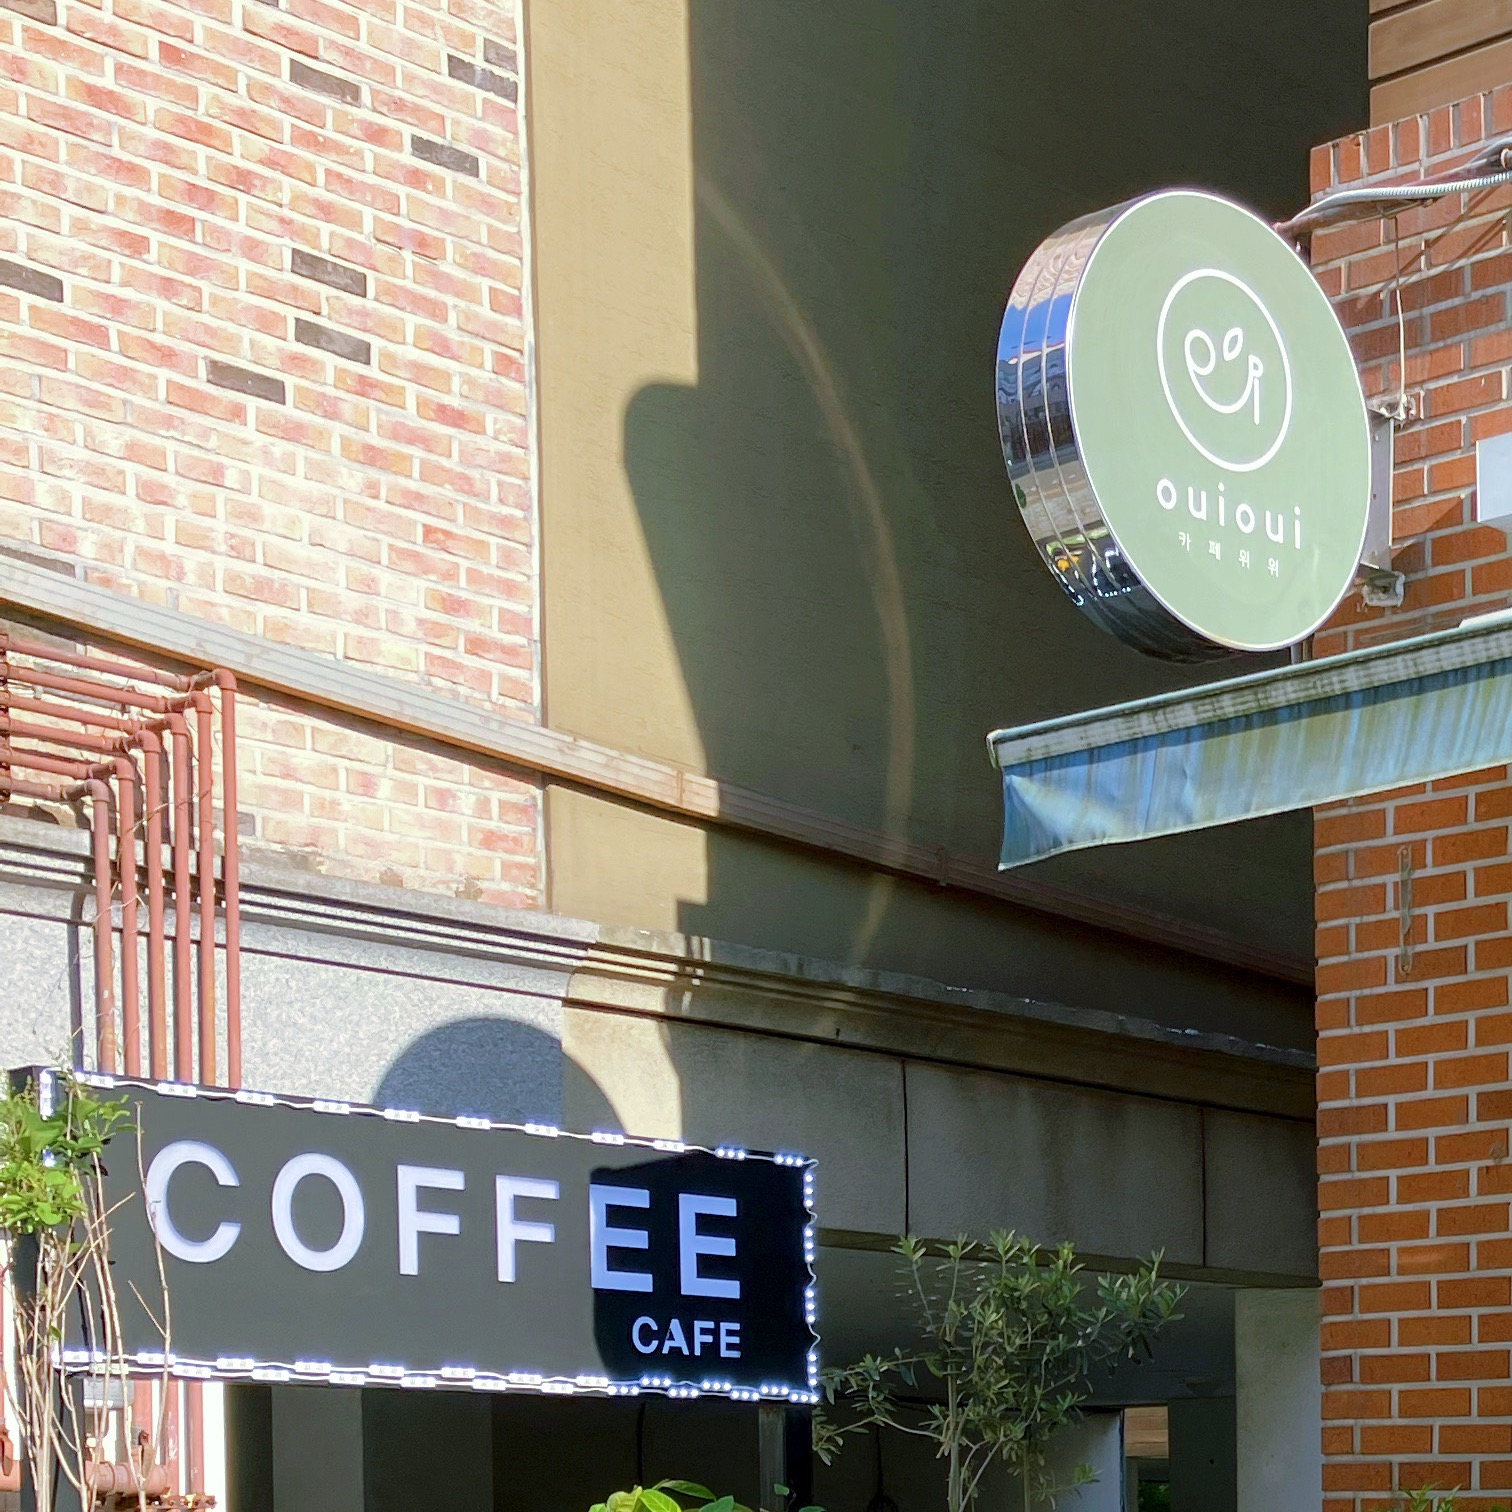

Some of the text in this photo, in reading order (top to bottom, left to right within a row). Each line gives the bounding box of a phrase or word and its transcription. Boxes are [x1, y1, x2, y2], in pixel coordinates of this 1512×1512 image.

[1156, 478, 1301, 550] ouioui
[144, 1139, 742, 1300] COFFEE
[631, 1315, 742, 1358] CAFE
